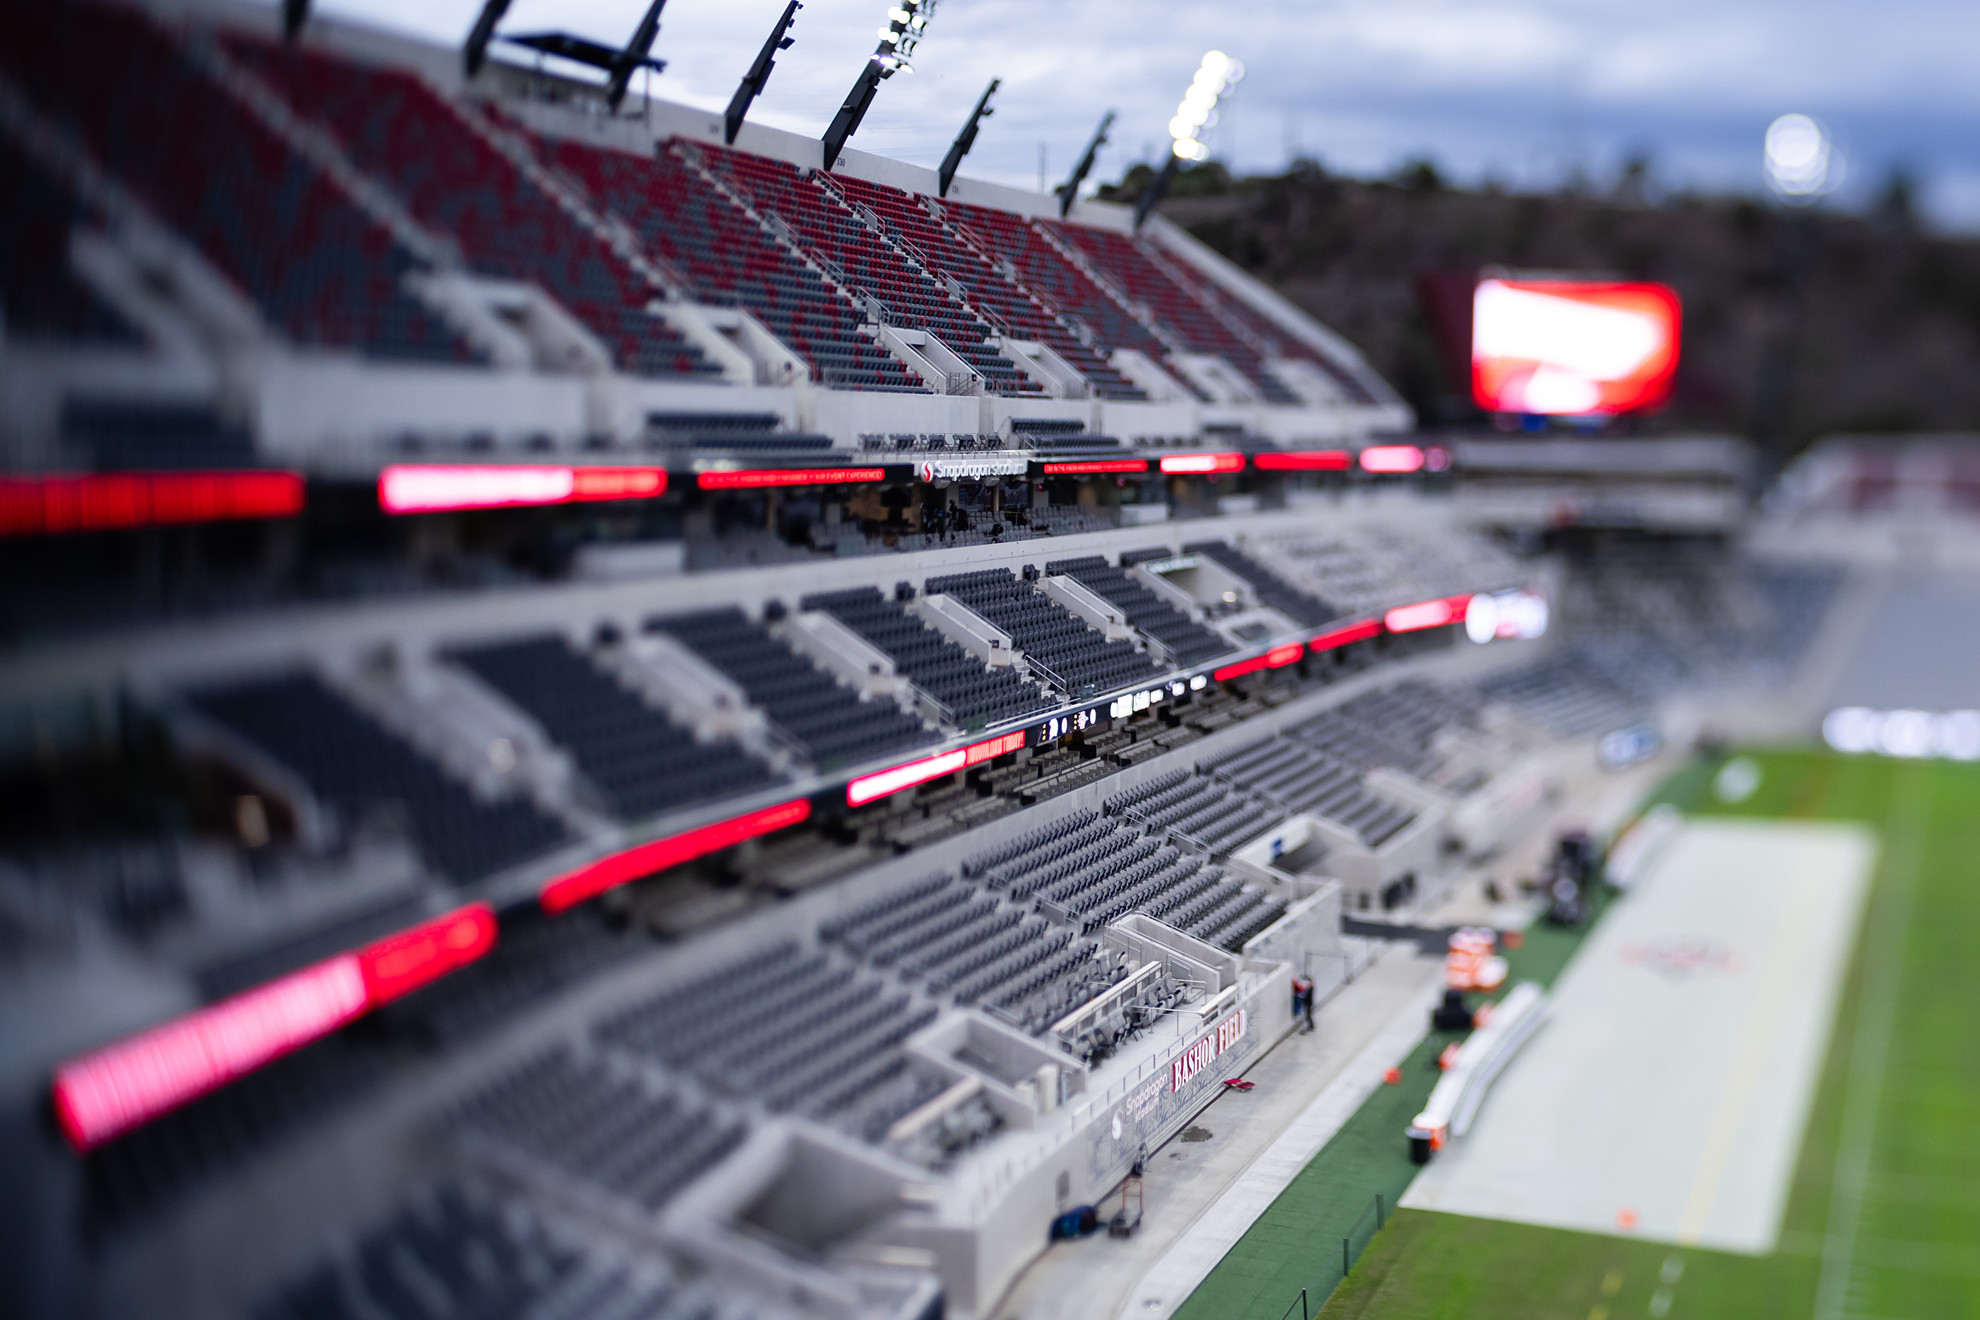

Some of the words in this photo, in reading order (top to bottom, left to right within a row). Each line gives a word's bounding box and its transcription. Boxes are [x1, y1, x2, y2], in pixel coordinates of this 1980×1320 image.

[836, 157, 846, 168] 330
[934, 460, 991, 481] Snapdragon
[992, 460, 1025, 475] stadium
[1003, 731, 1024, 753] TODAY!
[1172, 1032, 1216, 1093] BASHOR
[1217, 1008, 1248, 1055] FIELD
[1125, 1073, 1168, 1117] Snapdragon
[1135, 1097, 1160, 1124] stadium
